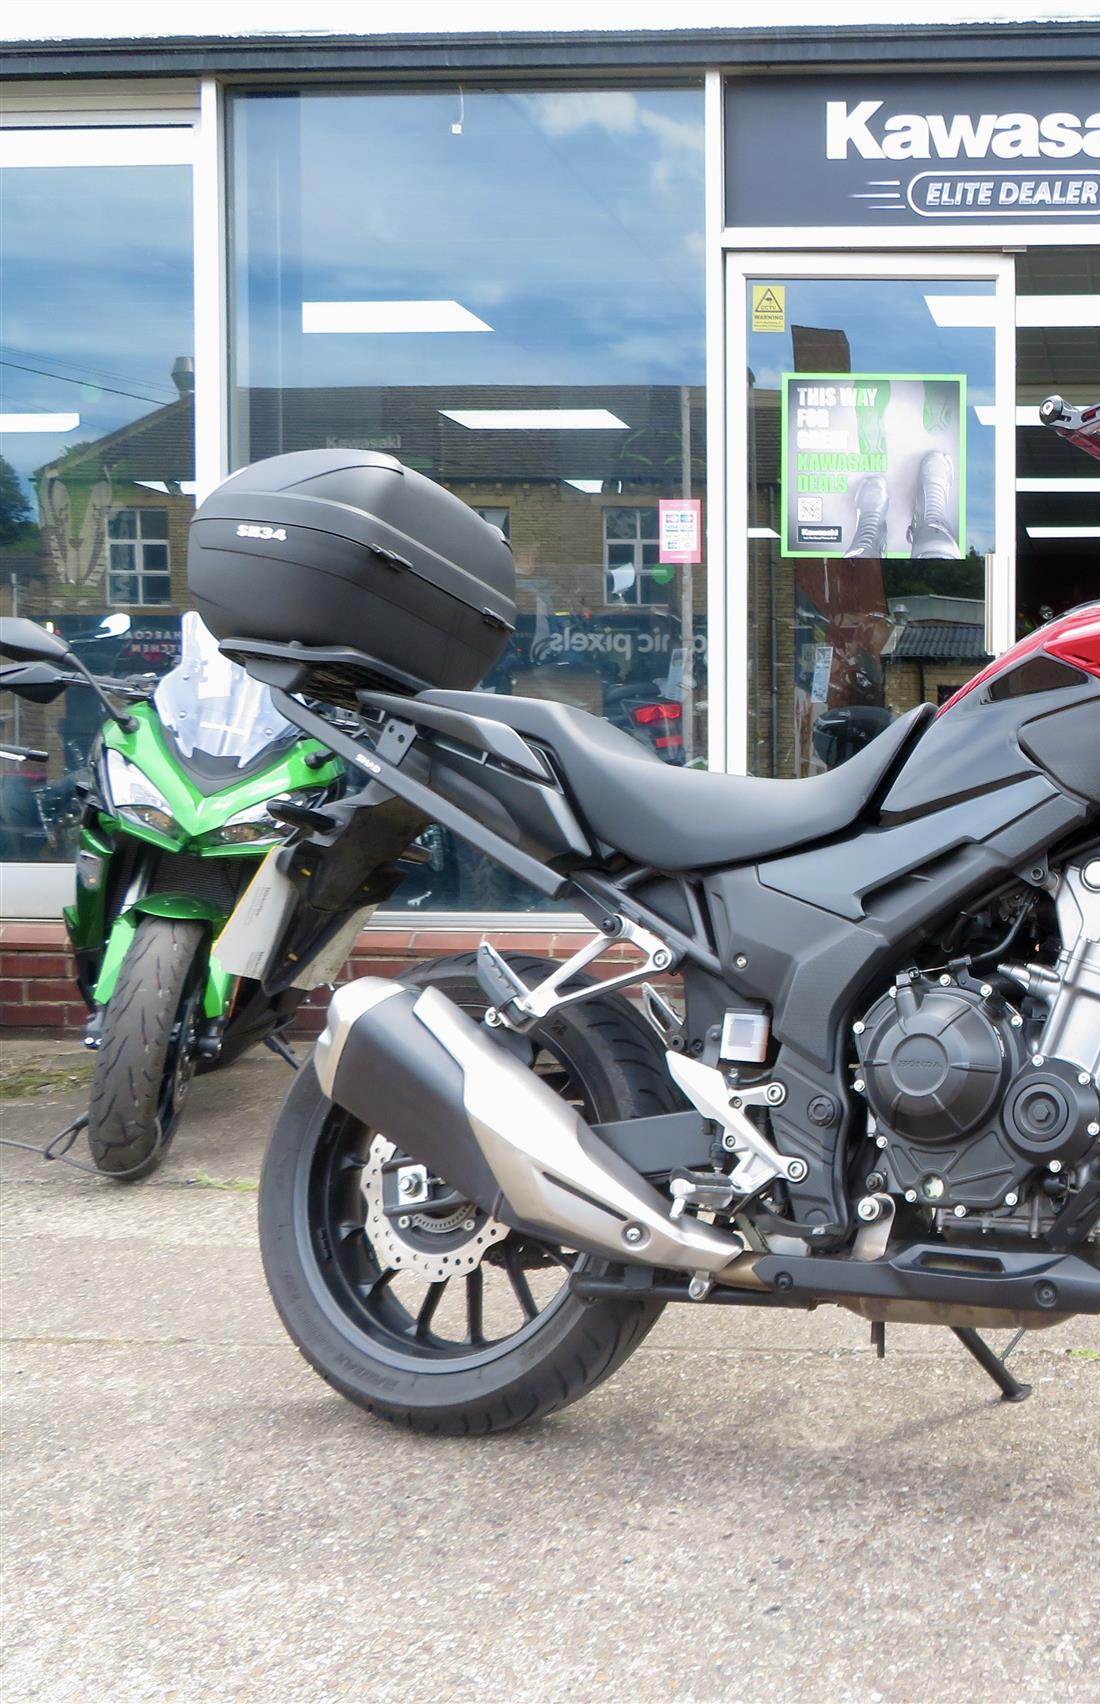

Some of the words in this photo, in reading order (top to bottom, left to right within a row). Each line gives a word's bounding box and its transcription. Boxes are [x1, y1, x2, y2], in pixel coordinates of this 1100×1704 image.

[925, 181, 995, 206] ELITE
[998, 180, 1098, 205] DEALER
[796, 387, 837, 406] THIS
[839, 387, 878, 407] WAY
[796, 408, 829, 427] FOR
[796, 452, 887, 472] KAWASAKI
[796, 473, 849, 493] DEALS
